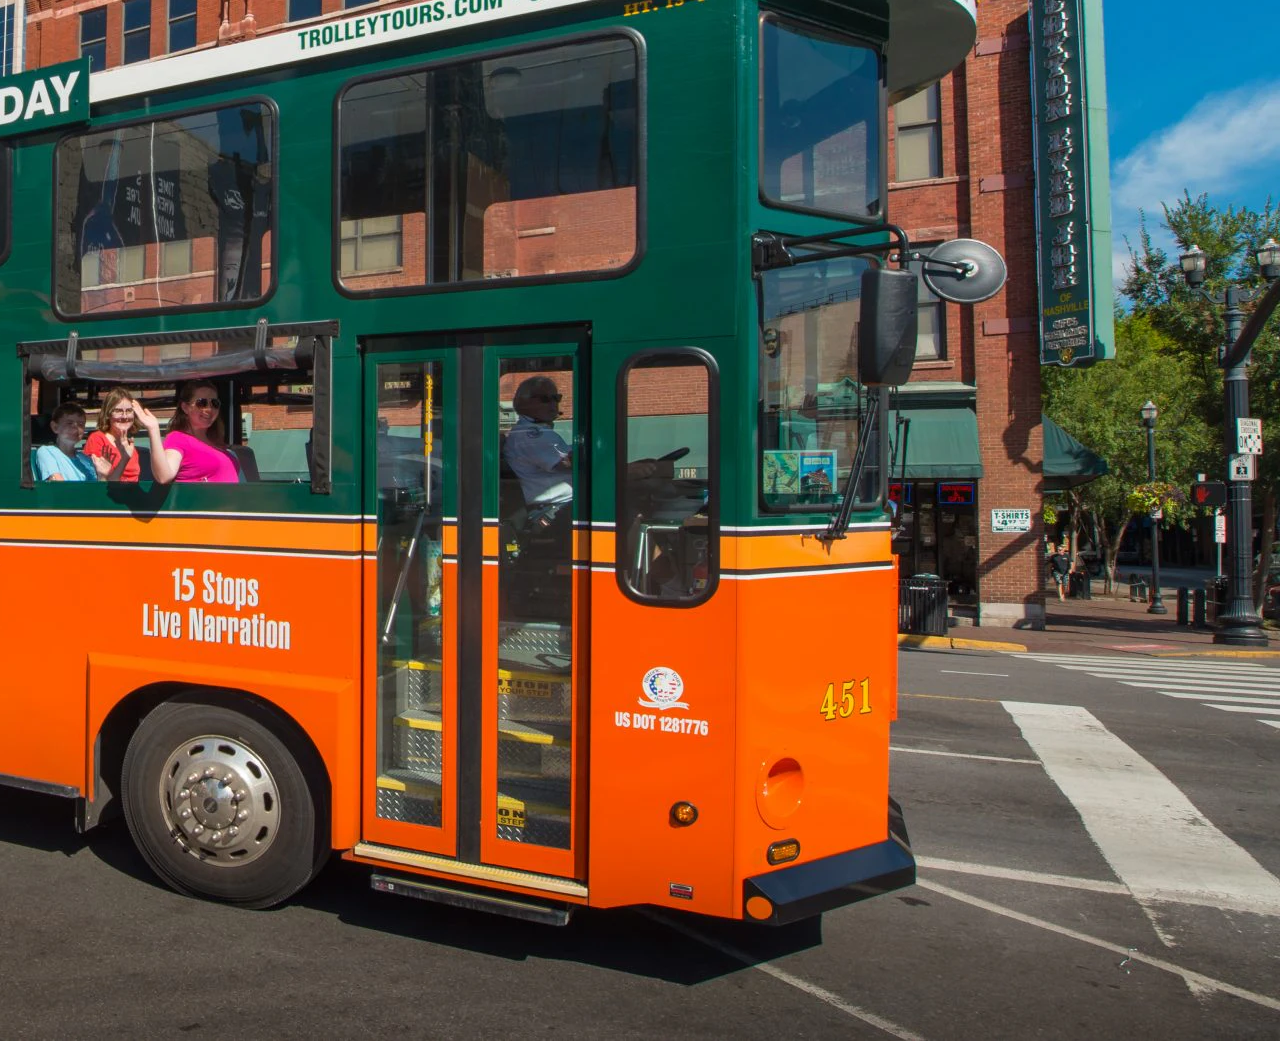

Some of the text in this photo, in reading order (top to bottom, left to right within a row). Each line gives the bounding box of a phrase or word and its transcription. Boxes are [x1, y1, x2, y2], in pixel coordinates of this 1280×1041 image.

[1044, 299, 1089, 316] NASHVILLE
[1060, 292, 1073, 302] OF
[678, 468, 697, 478] JOE
[172, 567, 259, 611] 15 Stops
[142, 603, 291, 650] Live Narration
[819, 676, 872, 721] 451
[615, 711, 709, 736] US DOT 1281776
